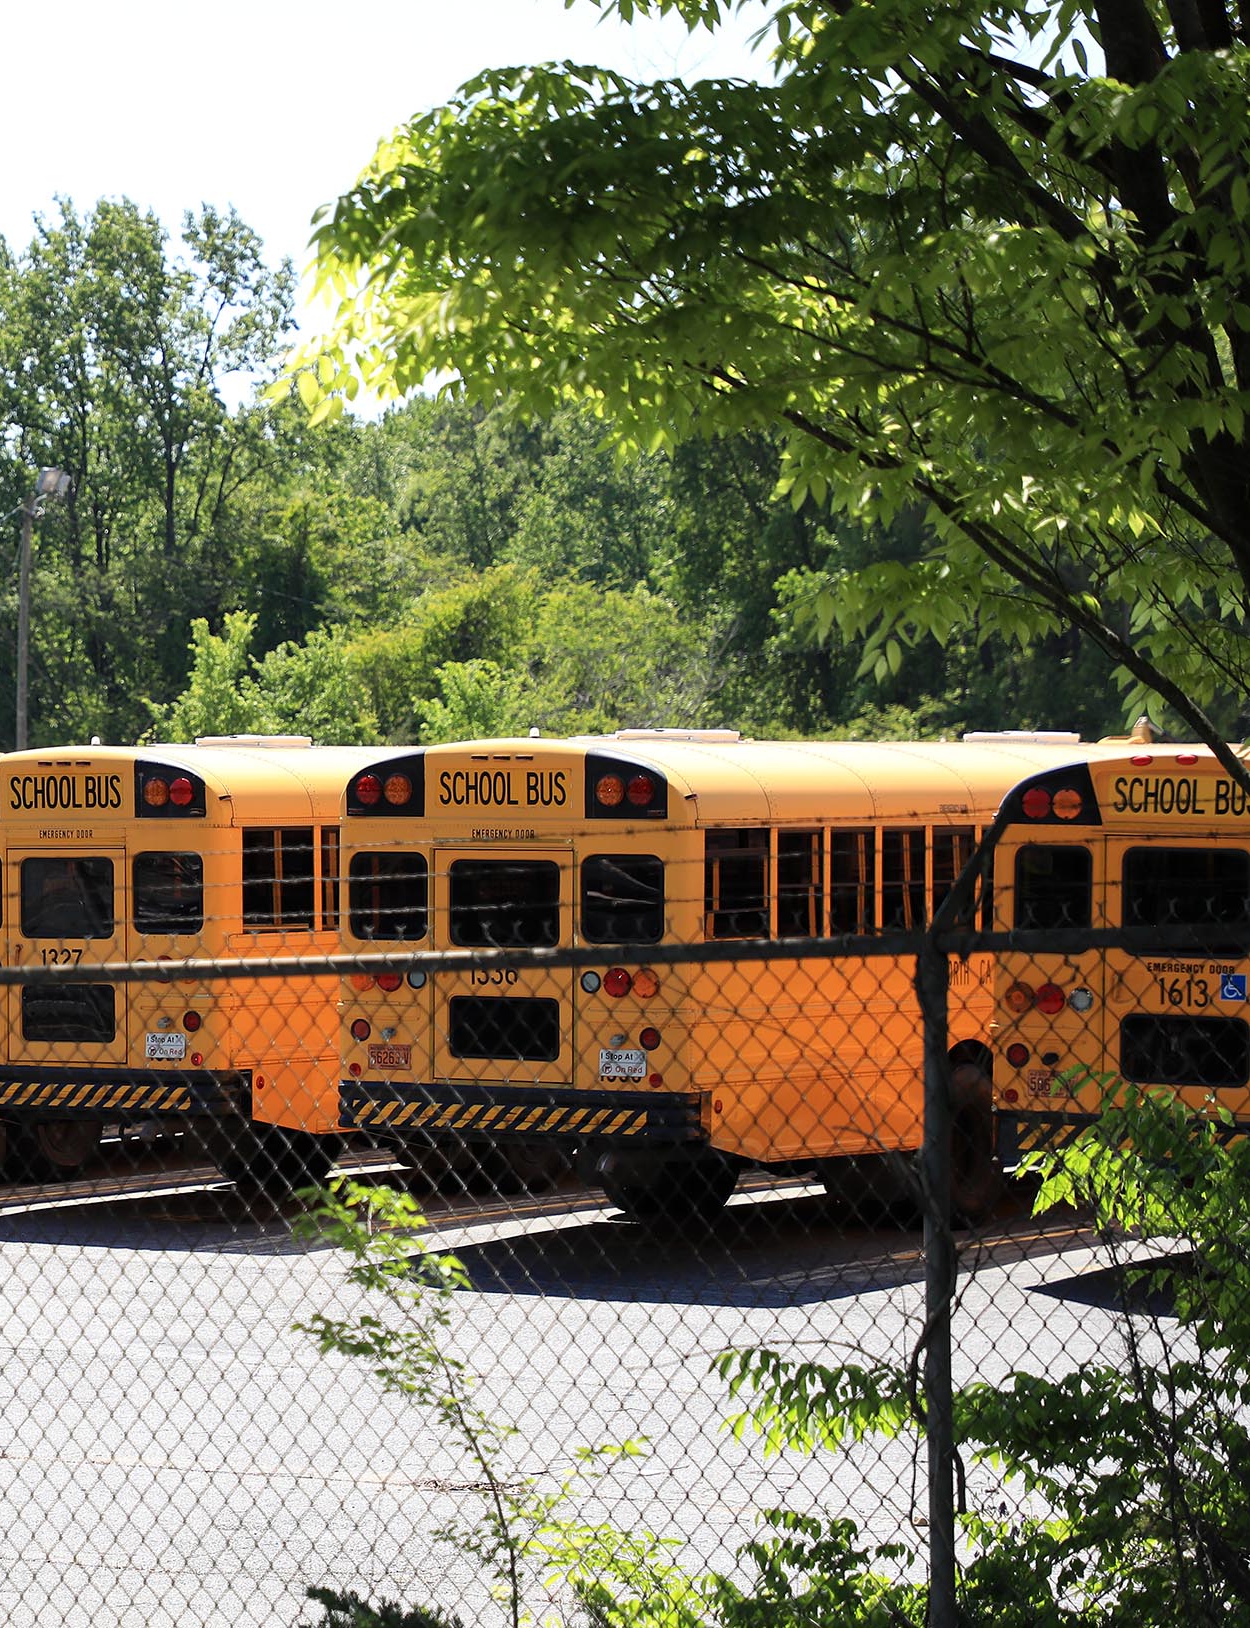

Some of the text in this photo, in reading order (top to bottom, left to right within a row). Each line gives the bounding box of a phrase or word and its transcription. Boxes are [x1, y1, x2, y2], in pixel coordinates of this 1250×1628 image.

[10, 775, 122, 809] SCHOOL BUS
[439, 771, 567, 806] SCHOOL BUS
[1113, 777, 1250, 816] SCHOOL BU
[39, 829, 93, 839] EMERGENCY DOOR
[472, 829, 535, 838] EMERGENCY DOOR
[41, 948, 82, 966] 1327
[1147, 962, 1235, 974] EMERGENCY DOOR
[1159, 977, 1208, 1007] 1613
[151, 1034, 165, 1043] Stop
[158, 1047, 183, 1056] On Red
[605, 1051, 623, 1061] Stop
[615, 1065, 627, 1073] On
